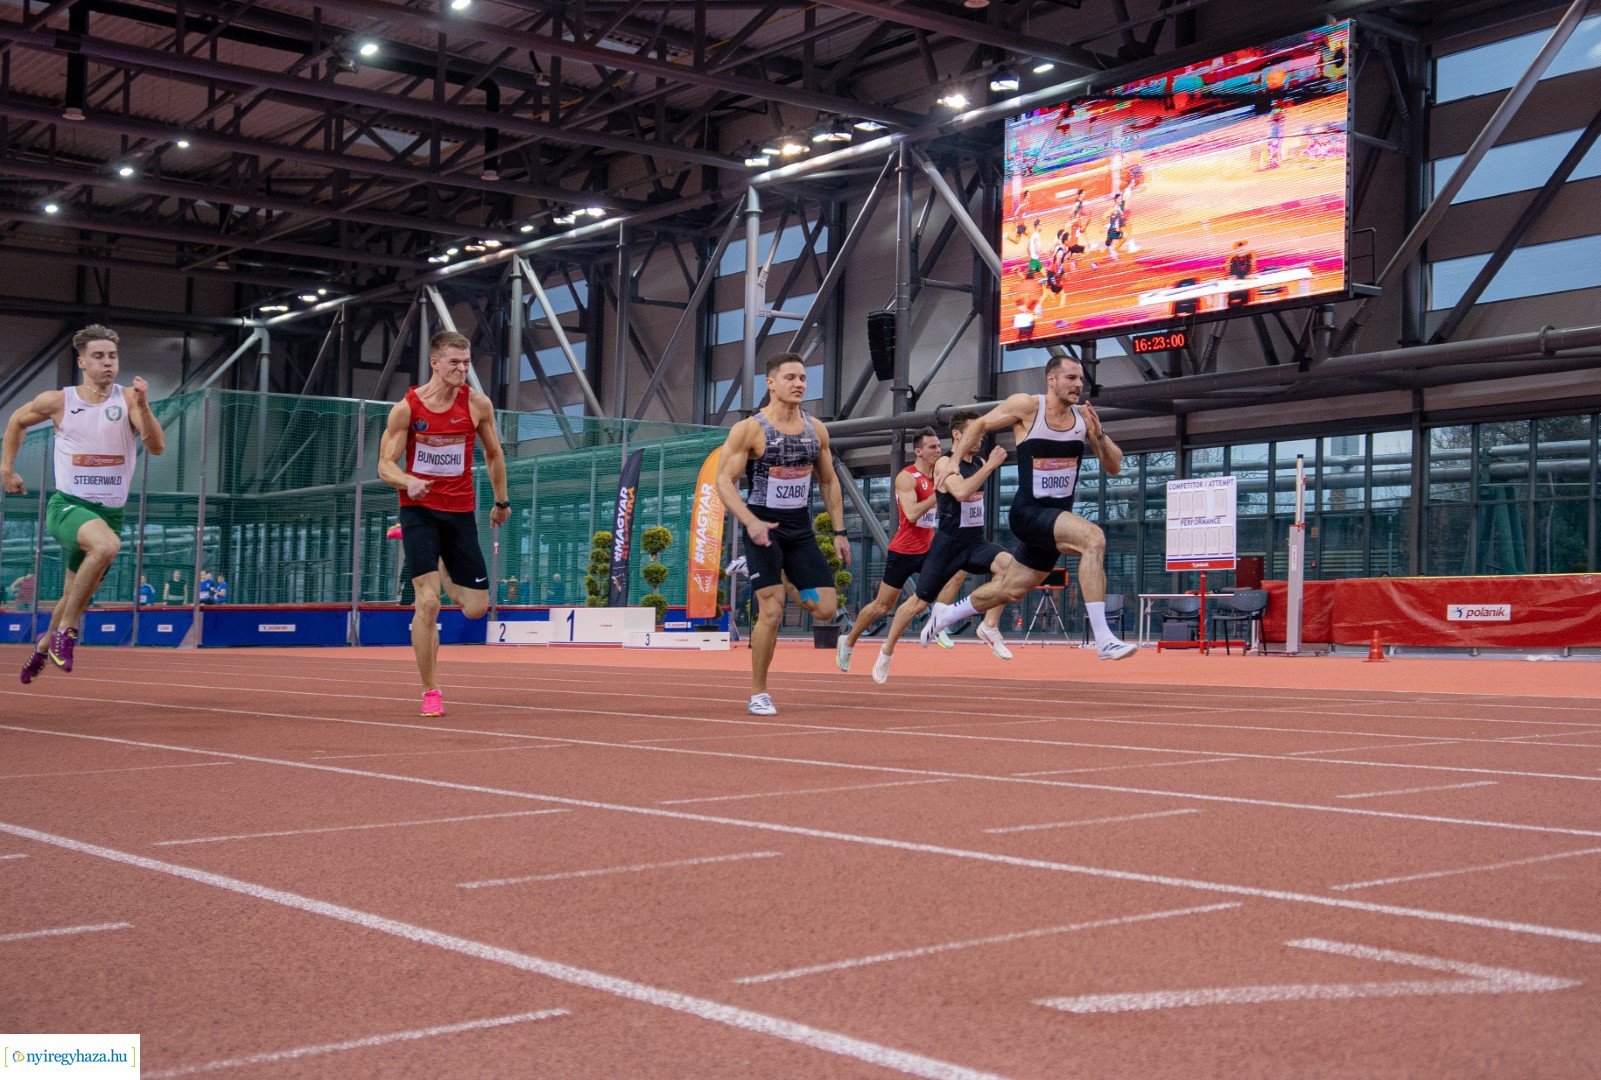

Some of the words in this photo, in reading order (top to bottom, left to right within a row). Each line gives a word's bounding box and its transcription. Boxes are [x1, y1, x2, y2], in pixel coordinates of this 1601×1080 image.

[1134, 333, 1185, 352] 16:23:00
[417, 450, 461, 465] BUNDSCHU
[74, 475, 122, 485] STEIGERWALD
[1041, 476, 1070, 489] BOROS
[1168, 481, 1203, 490] COMPETITOR
[1208, 479, 1234, 487] ATTEMPT
[694, 483, 712, 564] #MAGYAR
[1180, 518, 1221, 526] PERFORMANCE
[1466, 606, 1506, 619] polanik
[567, 609, 575, 641] 1
[499, 622, 506, 642] 2
[645, 633, 651, 646] 3
